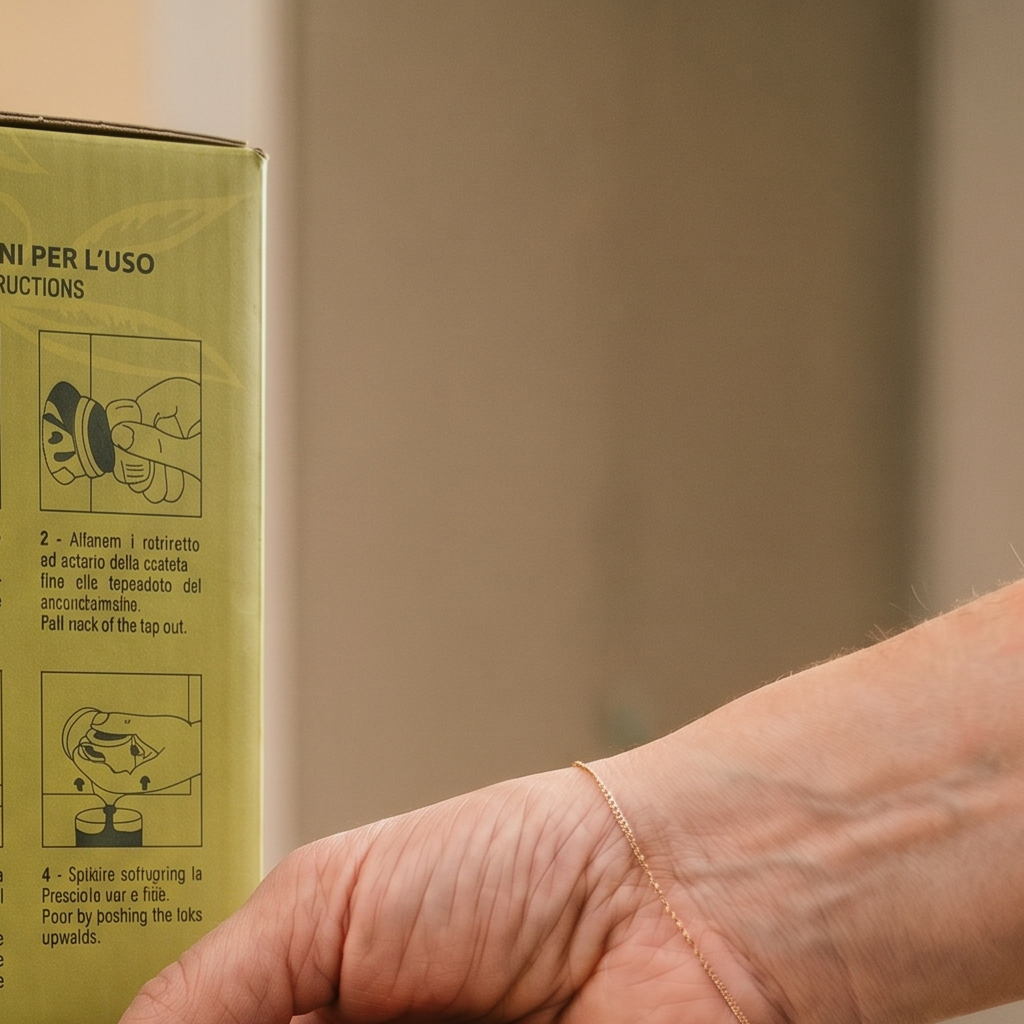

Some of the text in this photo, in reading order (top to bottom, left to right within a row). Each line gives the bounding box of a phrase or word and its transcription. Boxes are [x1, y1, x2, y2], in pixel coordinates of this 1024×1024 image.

[31, 245, 78, 269] PER
[40, 531, 48, 546] 2
[131, 534, 134, 548] i
[61, 554, 105, 569] actario
[110, 554, 139, 570] della
[109, 576, 172, 593] tepeadoto
[183, 578, 201, 593] del
[102, 617, 114, 632] of
[117, 617, 137, 633] the
[140, 619, 159, 637] tap
[163, 620, 187, 634] out.
[42, 867, 50, 882] 4
[192, 866, 202, 881] la
[131, 890, 138, 901] e
[42, 909, 73, 924] Poor
[78, 909, 92, 927] by
[152, 908, 172, 922] the
[42, 929, 101, 948] upwalds.
